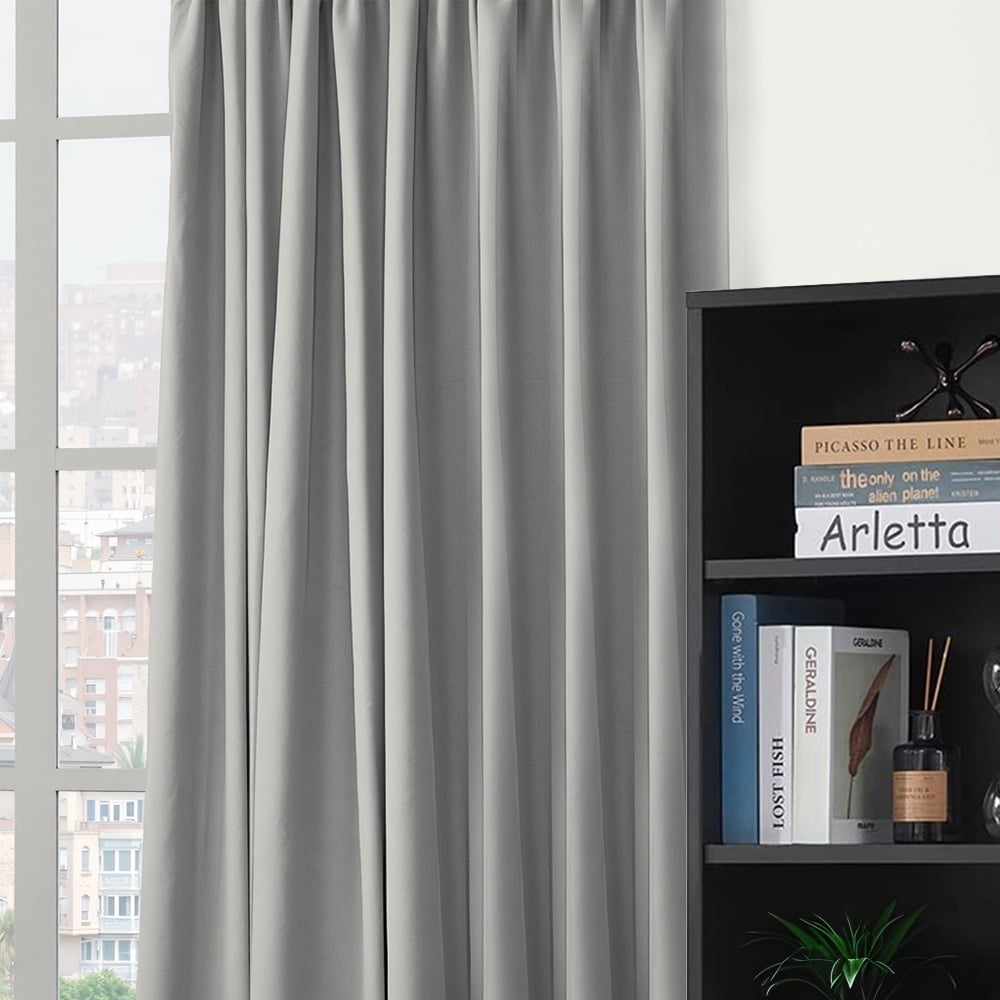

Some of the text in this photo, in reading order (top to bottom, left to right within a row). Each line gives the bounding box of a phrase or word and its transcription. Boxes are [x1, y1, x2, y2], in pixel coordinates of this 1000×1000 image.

[815, 436, 967, 454] PICASSO THE LINE
[840, 468, 868, 489] the
[869, 471, 895, 488] only
[902, 472, 918, 482] on
[920, 468, 940, 481] the
[868, 486, 940, 503] alien planet
[820, 511, 970, 552] Arletta
[731, 611, 745, 724] Gone with the Wind
[805, 647, 817, 734] GERALDINE
[772, 737, 785, 829] LOST FISH
